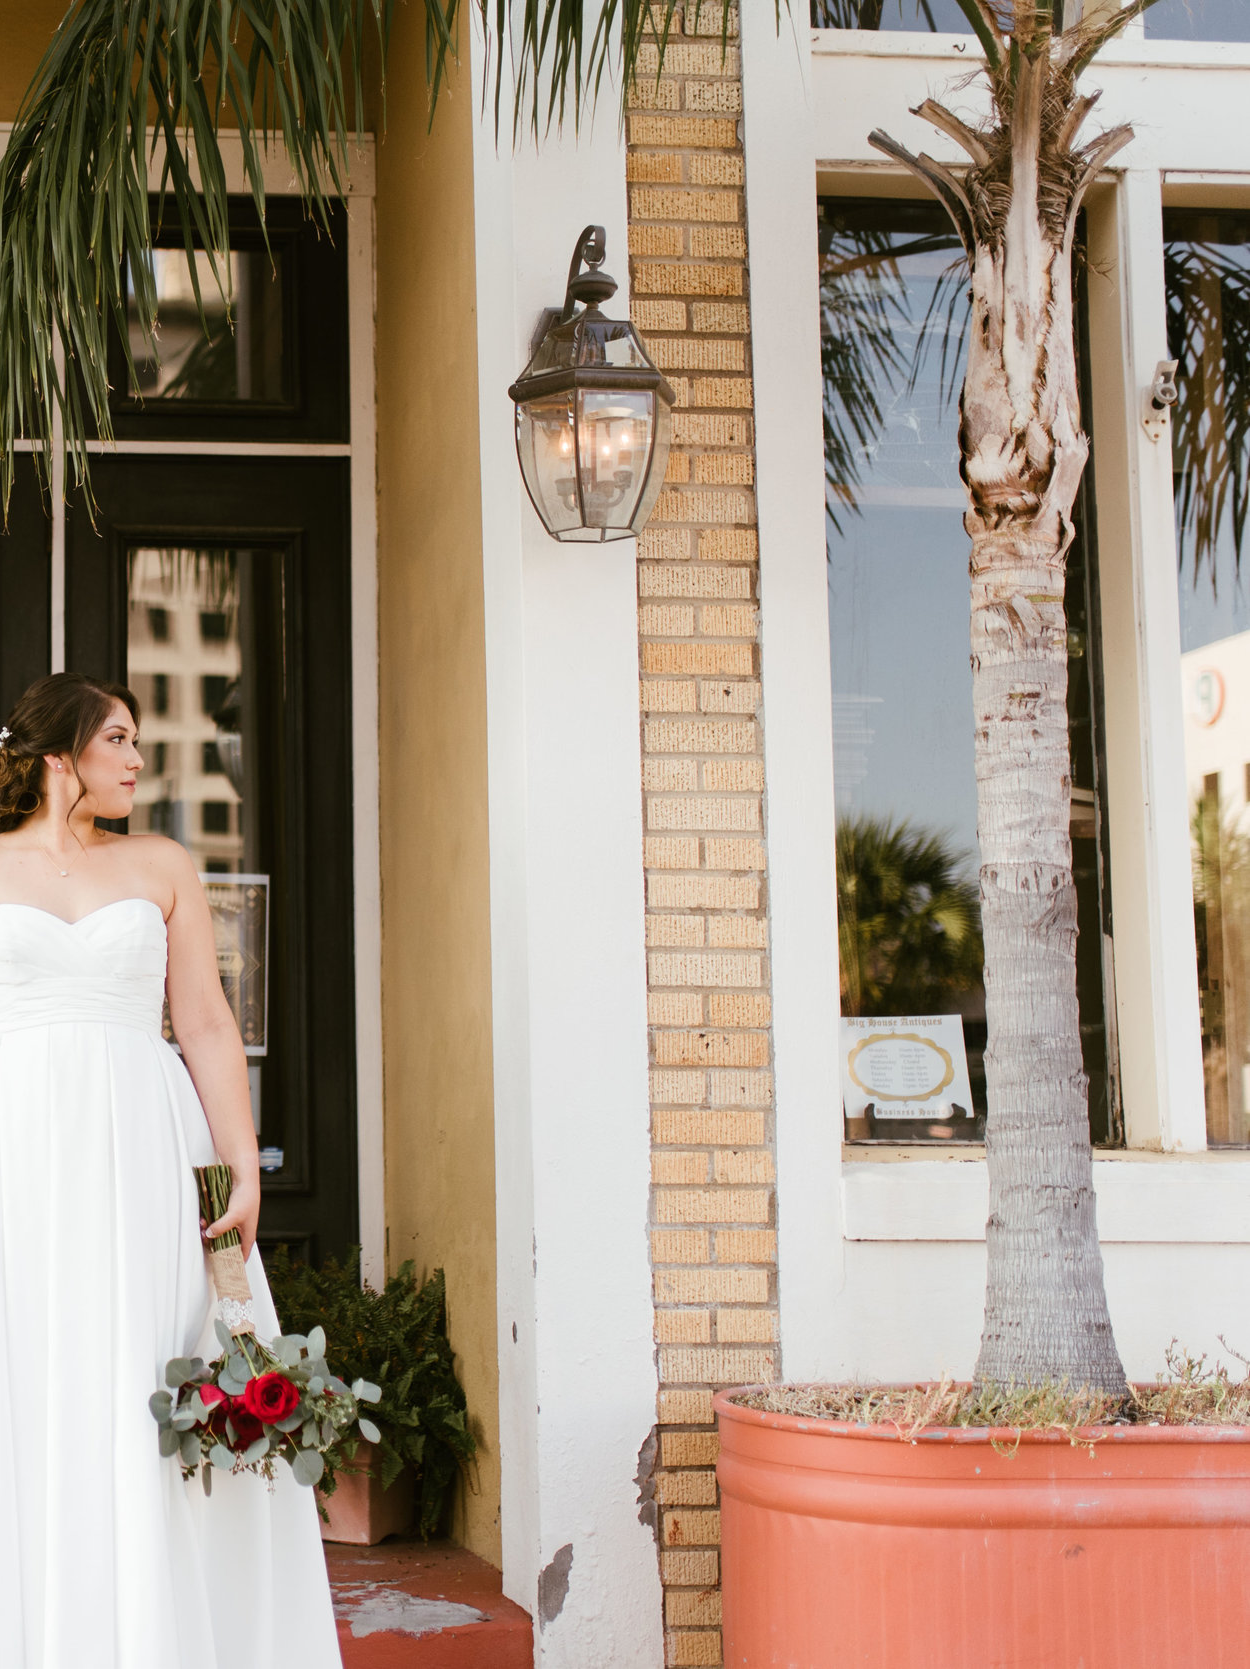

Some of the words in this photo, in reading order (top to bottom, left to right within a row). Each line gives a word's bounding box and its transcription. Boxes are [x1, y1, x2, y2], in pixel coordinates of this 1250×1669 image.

[847, 1017, 865, 1028] Big
[867, 1017, 898, 1028] House
[900, 1017, 943, 1027] Antiques
[876, 1107, 915, 1116] Business
